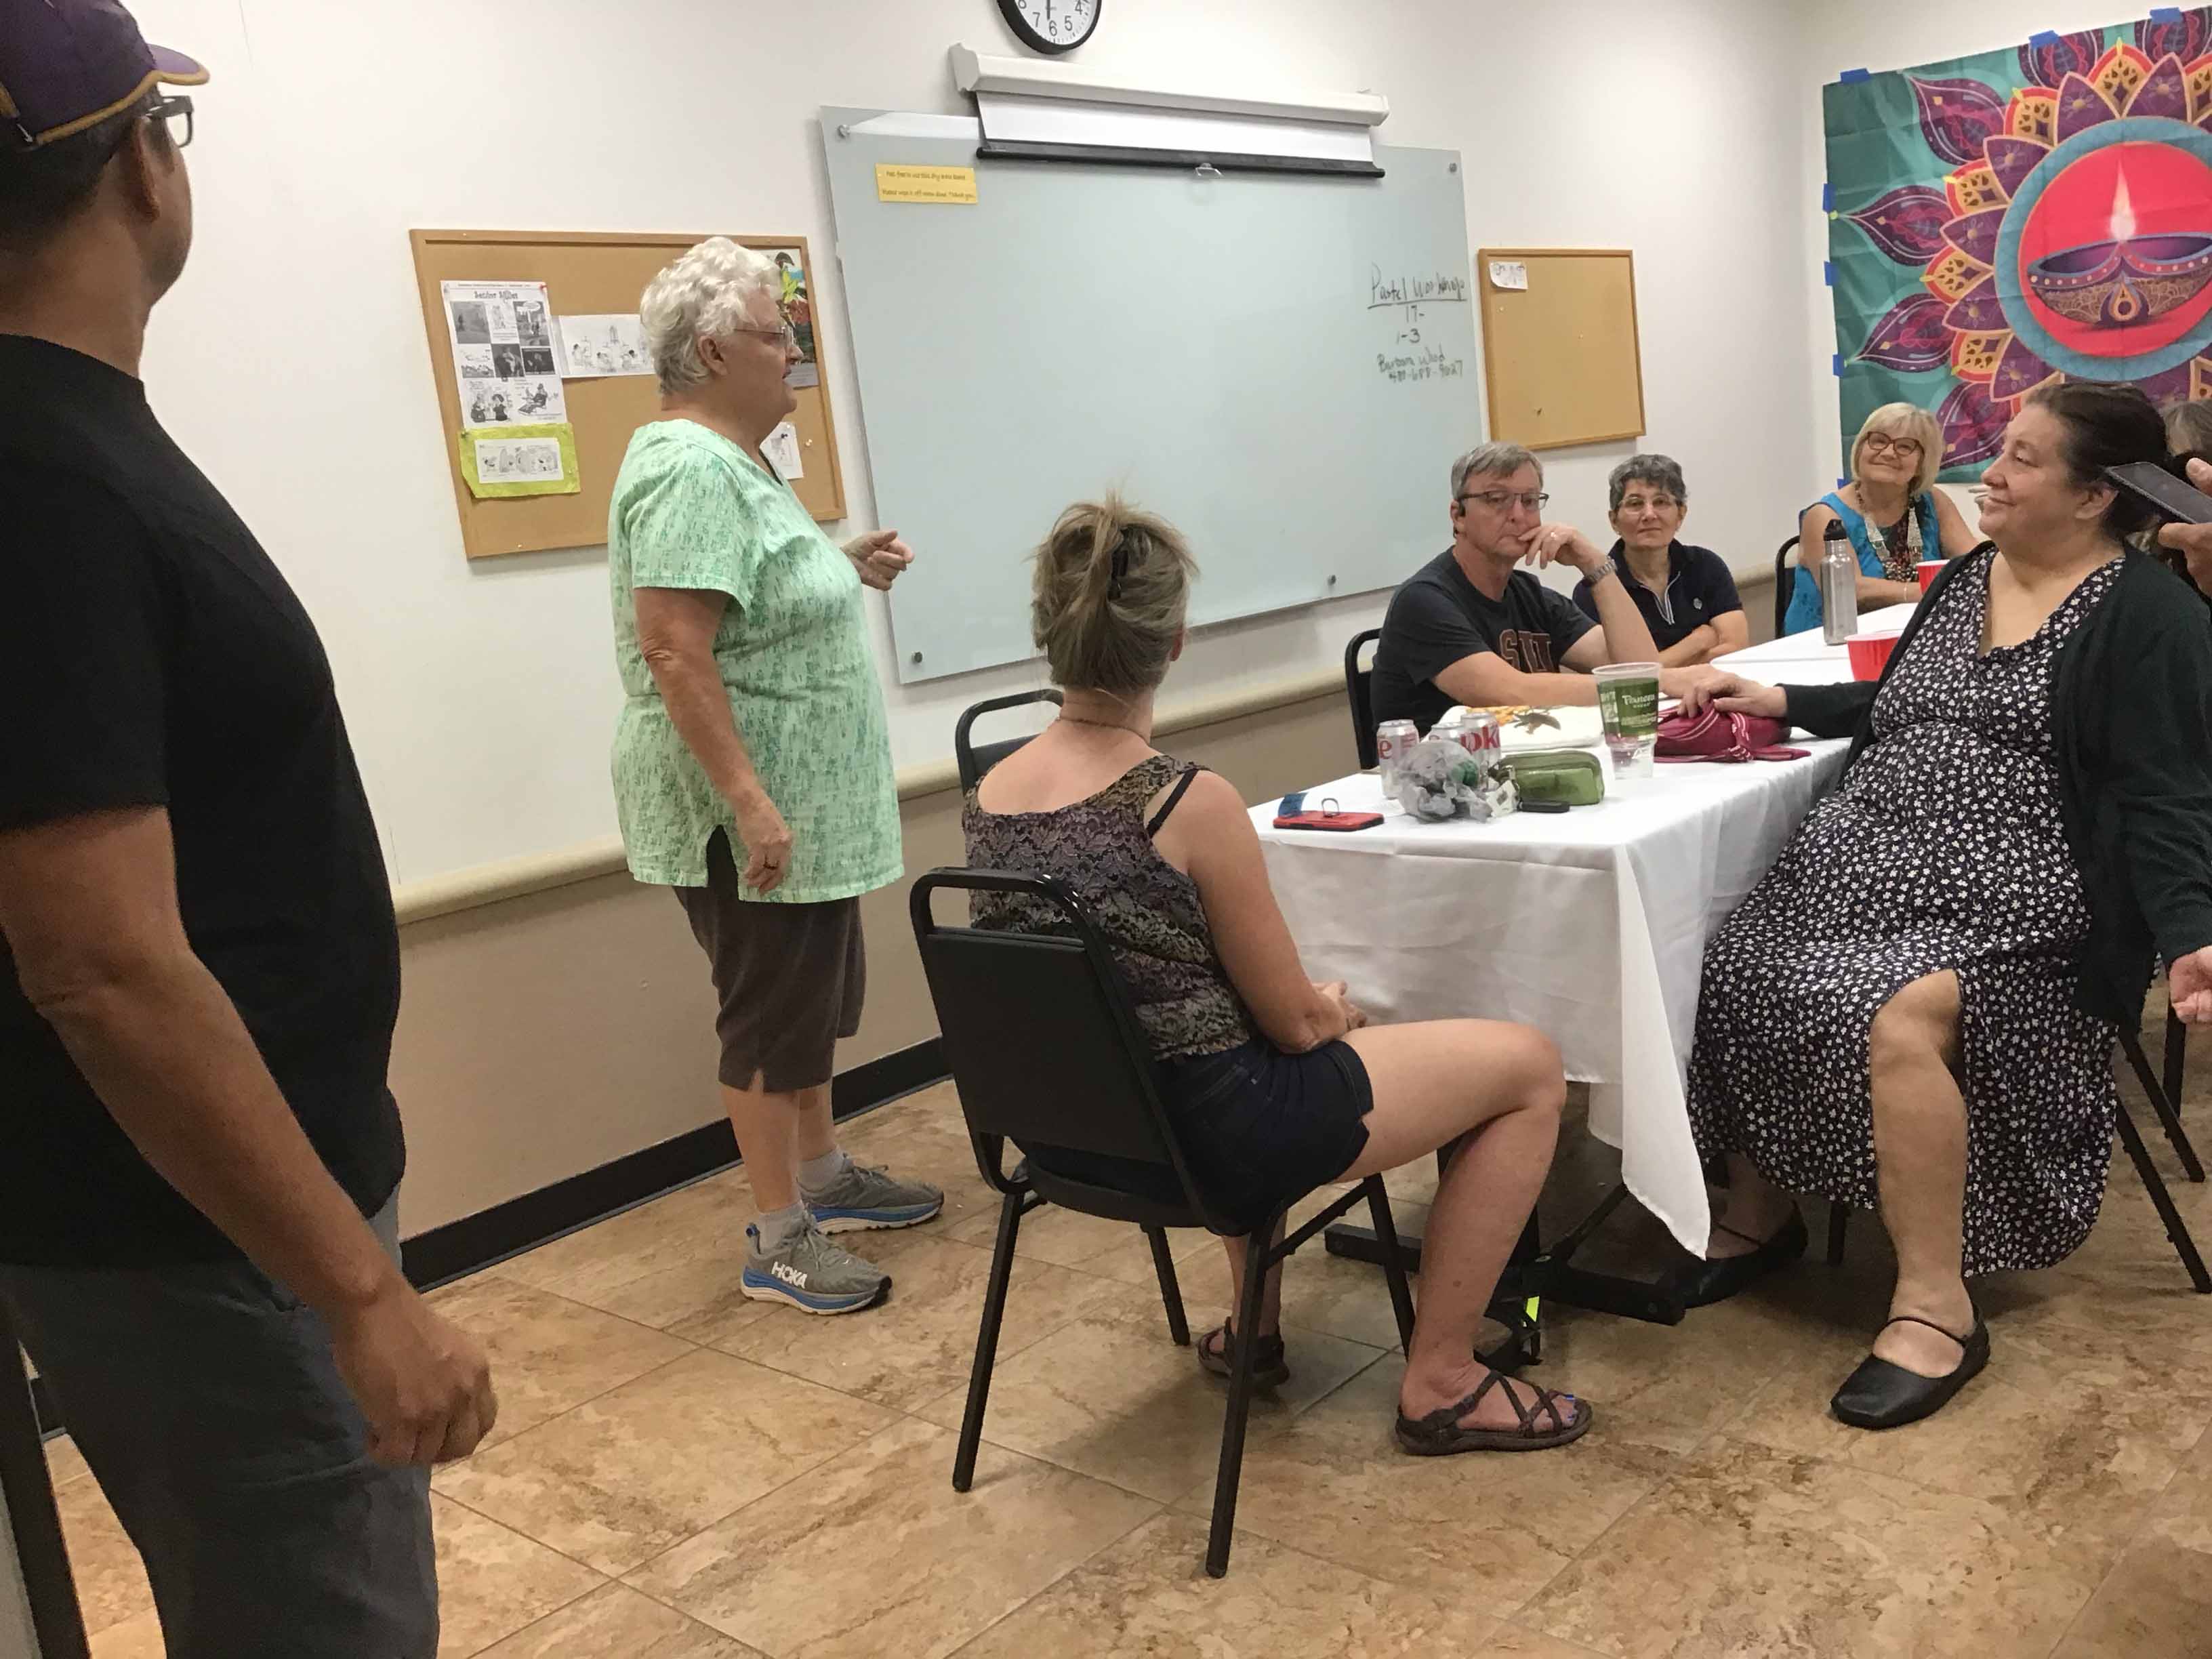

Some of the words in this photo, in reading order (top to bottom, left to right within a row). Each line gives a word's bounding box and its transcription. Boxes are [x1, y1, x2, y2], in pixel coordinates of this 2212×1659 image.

[1075, 0, 1082, 15] 4
[1032, 12, 1040, 27] 7
[1064, 16, 1073, 31] 5
[1049, 20, 1057, 37] 6
[1371, 261, 1408, 304] Pastel
[1396, 328, 1420, 345] 1-3
[771, 1261, 808, 1289] HOKA
